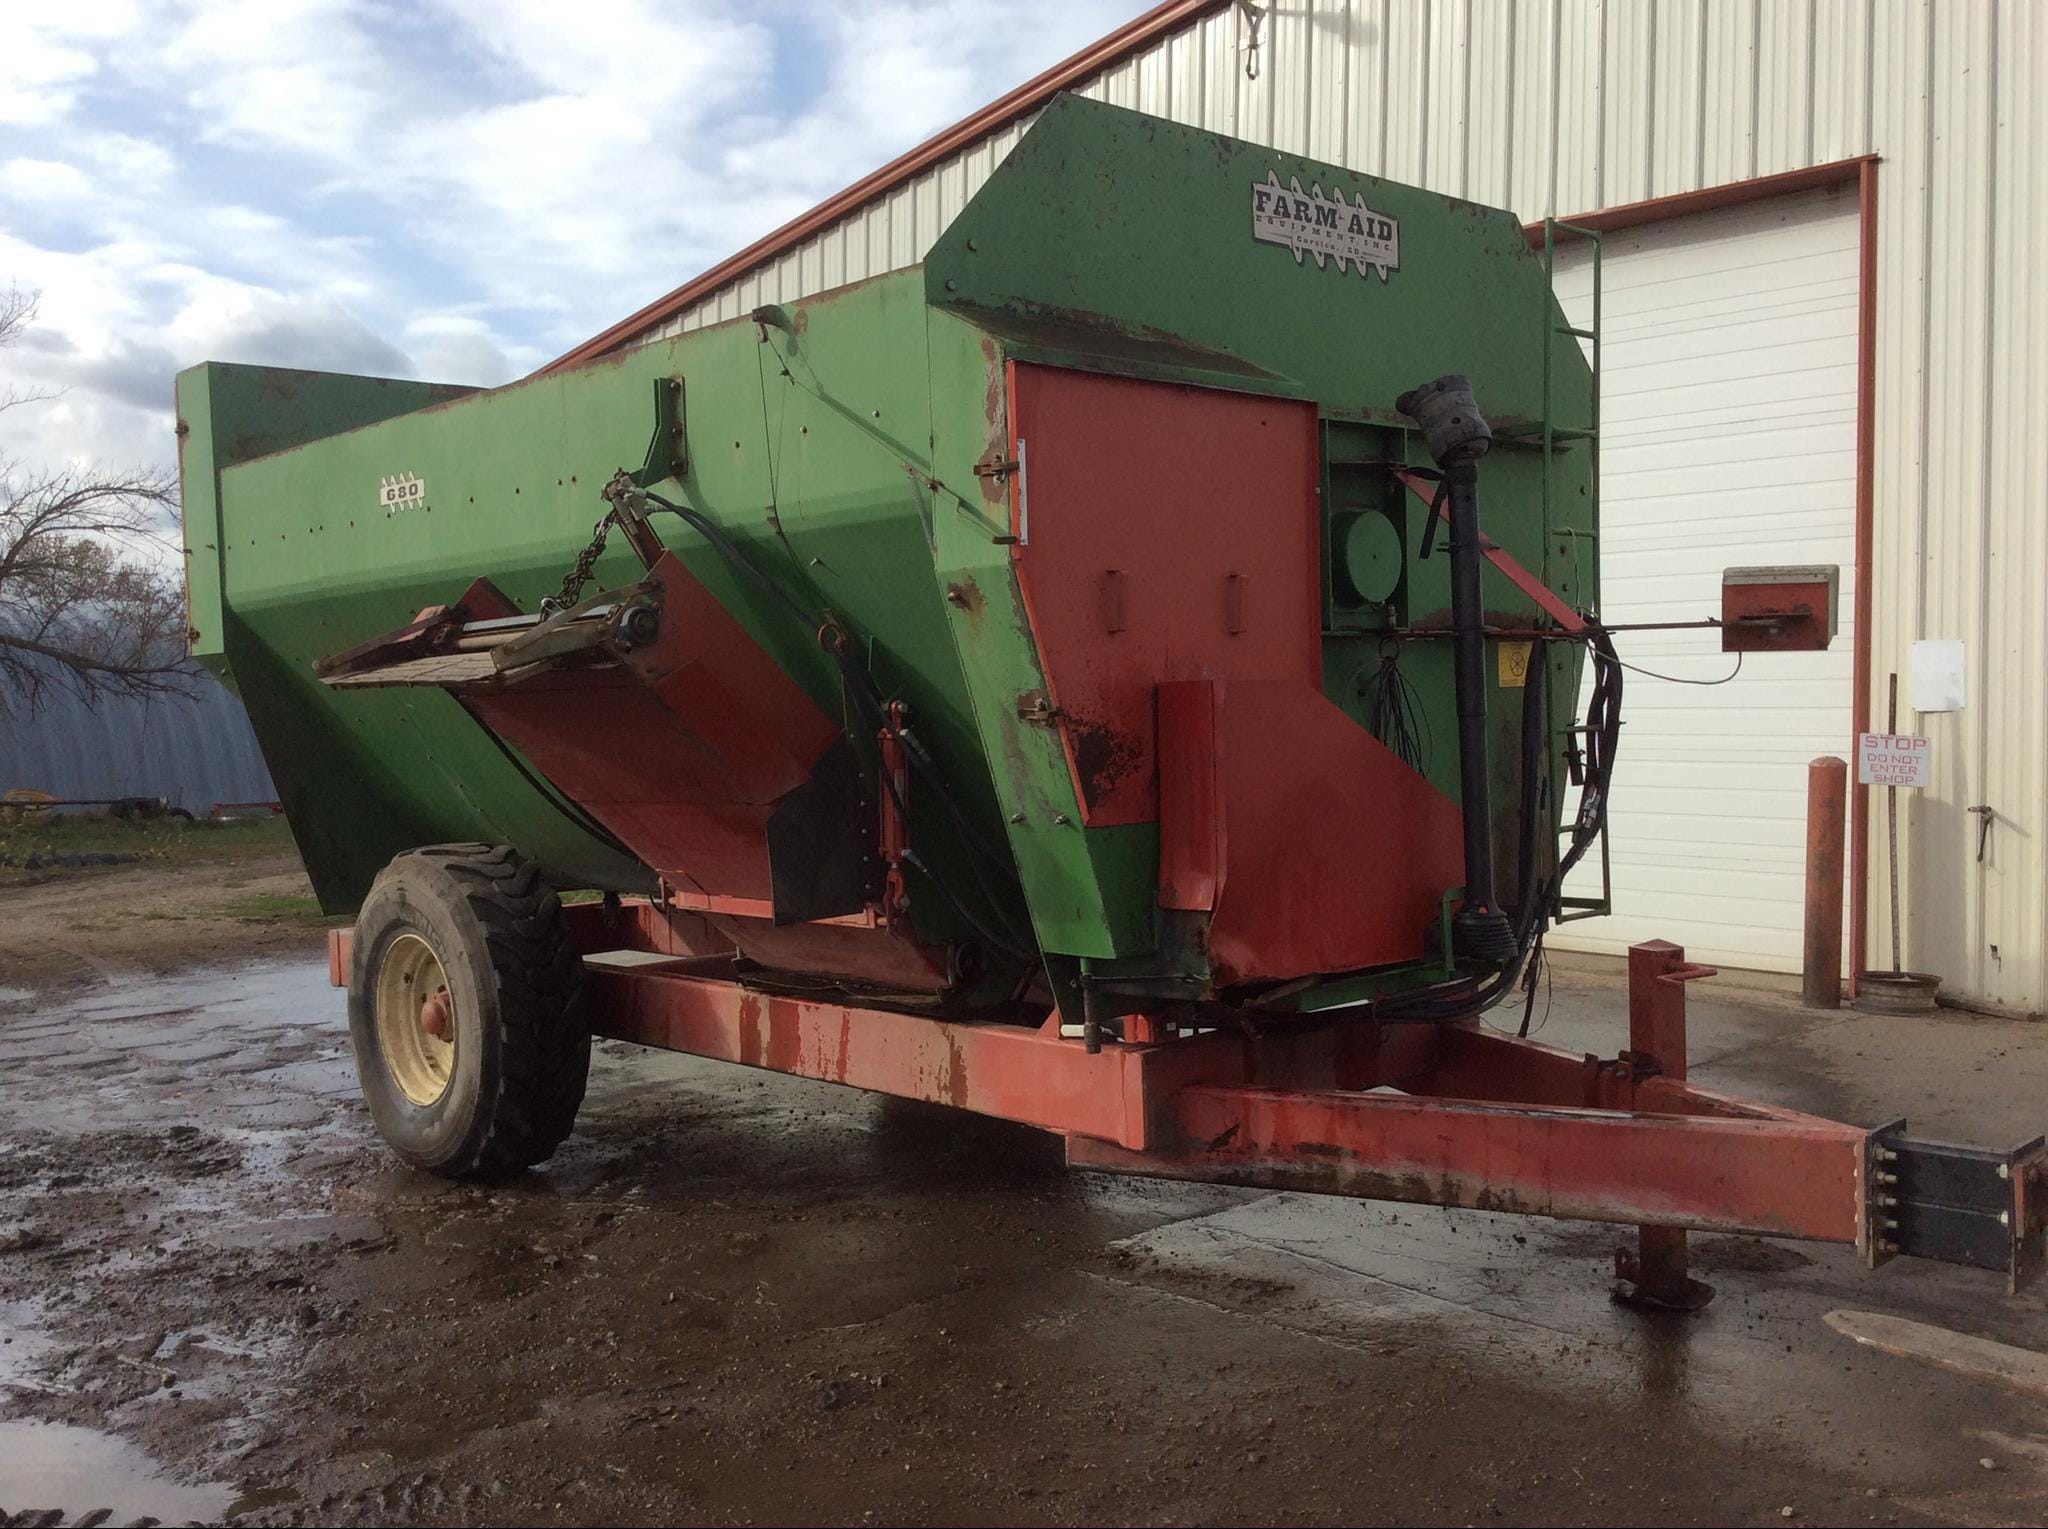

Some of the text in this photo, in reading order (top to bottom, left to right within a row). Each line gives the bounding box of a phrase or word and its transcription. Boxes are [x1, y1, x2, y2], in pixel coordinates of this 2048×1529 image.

[1256, 190, 1392, 241] FARM AID
[386, 483, 418, 501] 680
[1865, 735, 1927, 750] STOP
[1867, 752, 1922, 765] DO NOT
[1870, 763, 1917, 775] ENTER
[1874, 774, 1914, 784] SHOP
